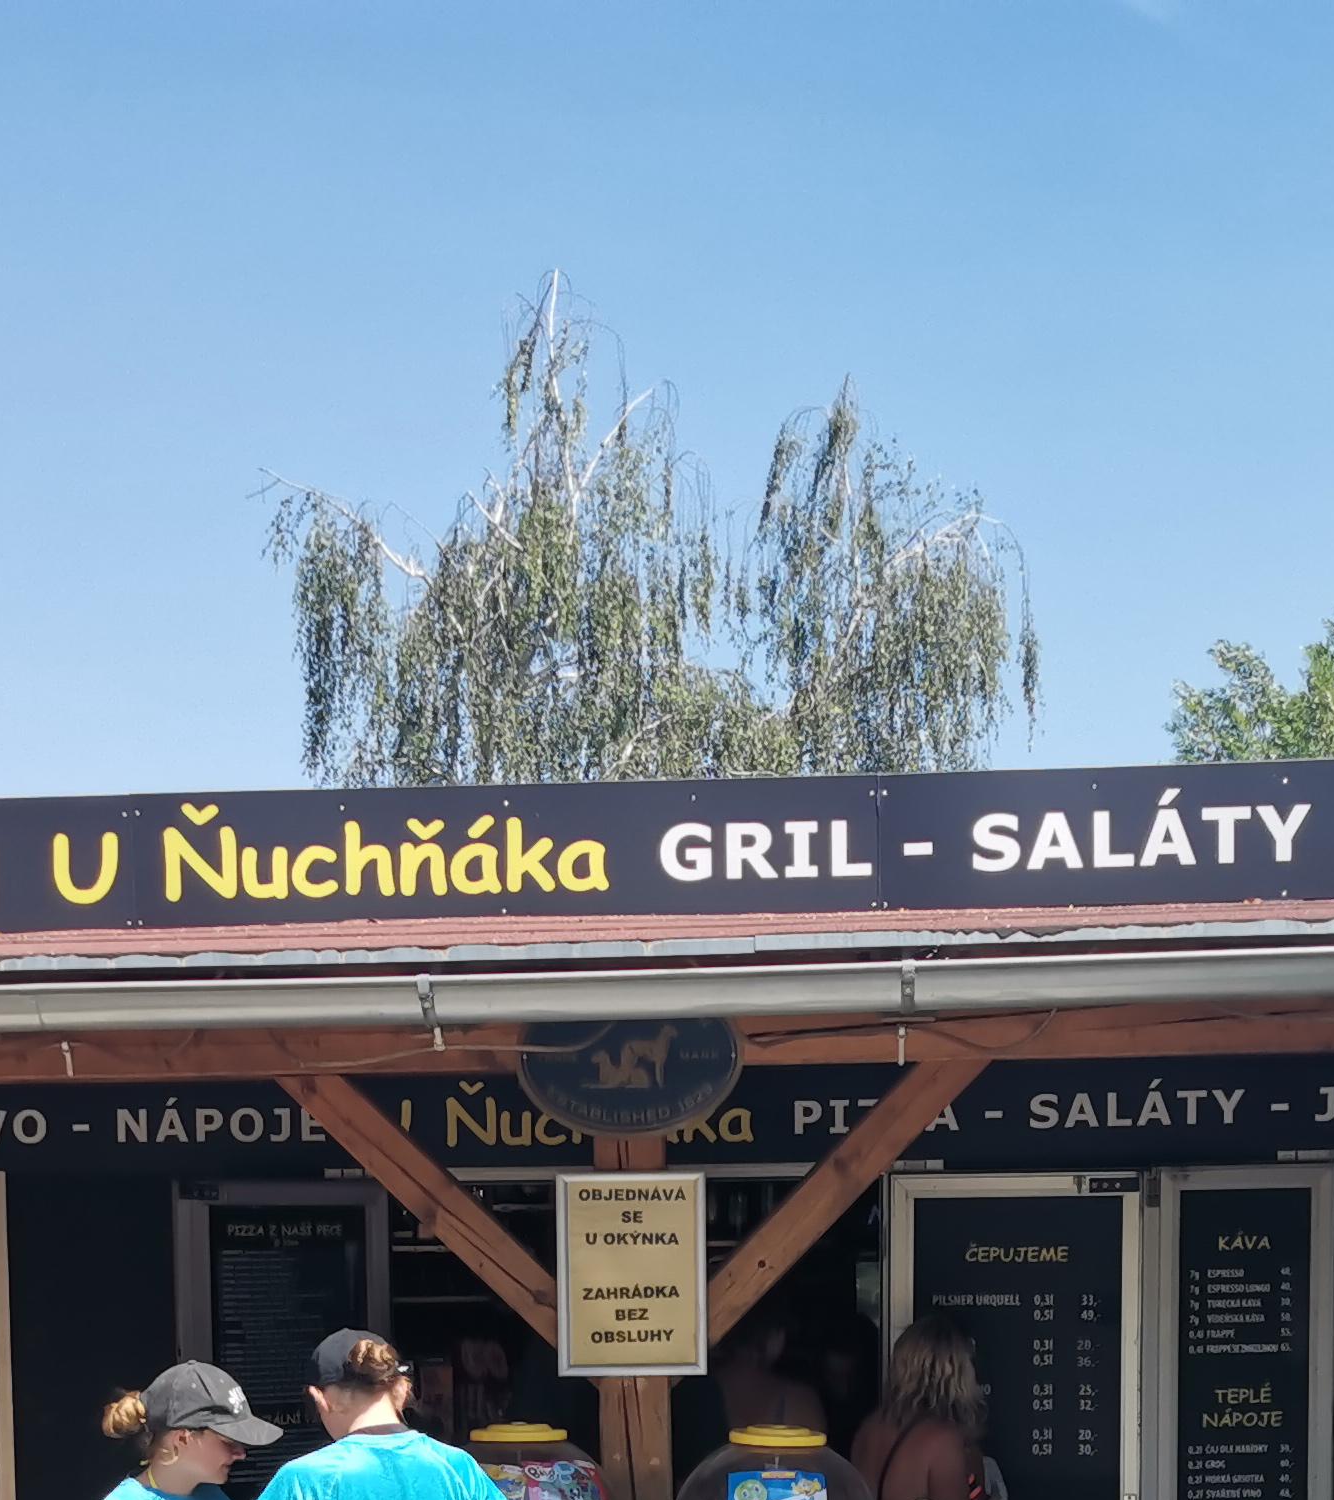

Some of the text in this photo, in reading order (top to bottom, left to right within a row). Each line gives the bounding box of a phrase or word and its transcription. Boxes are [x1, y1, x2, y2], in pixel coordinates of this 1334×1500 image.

[52, 832, 119, 905] U
[163, 803, 610, 903] Ňuchňáka
[659, 820, 873, 882] GRIL
[971, 787, 1312, 873] SALÁTY
[116, 1096, 325, 1143] NÁPOJE
[794, 1098, 959, 1135] PIA
[1029, 1078, 1245, 1129] SALÁTY
[578, 1187, 686, 1202] OBJEDNÁVÁ
[621, 1210, 643, 1224] SE
[585, 1229, 679, 1245] U OKÝNKA
[1218, 1230, 1271, 1251] KÁVA
[965, 1241, 1069, 1263] ČEPUJEME
[582, 1284, 680, 1301] ZAHRÁDKA
[932, 1294, 974, 1306] PILSNER
[975, 1294, 1022, 1307] URQUELL
[615, 1308, 649, 1321] BEZ
[590, 1329, 674, 1344] OBSLUHY
[1214, 1382, 1272, 1404] TEPLÉ
[1202, 1407, 1284, 1428] NÁPOJE
